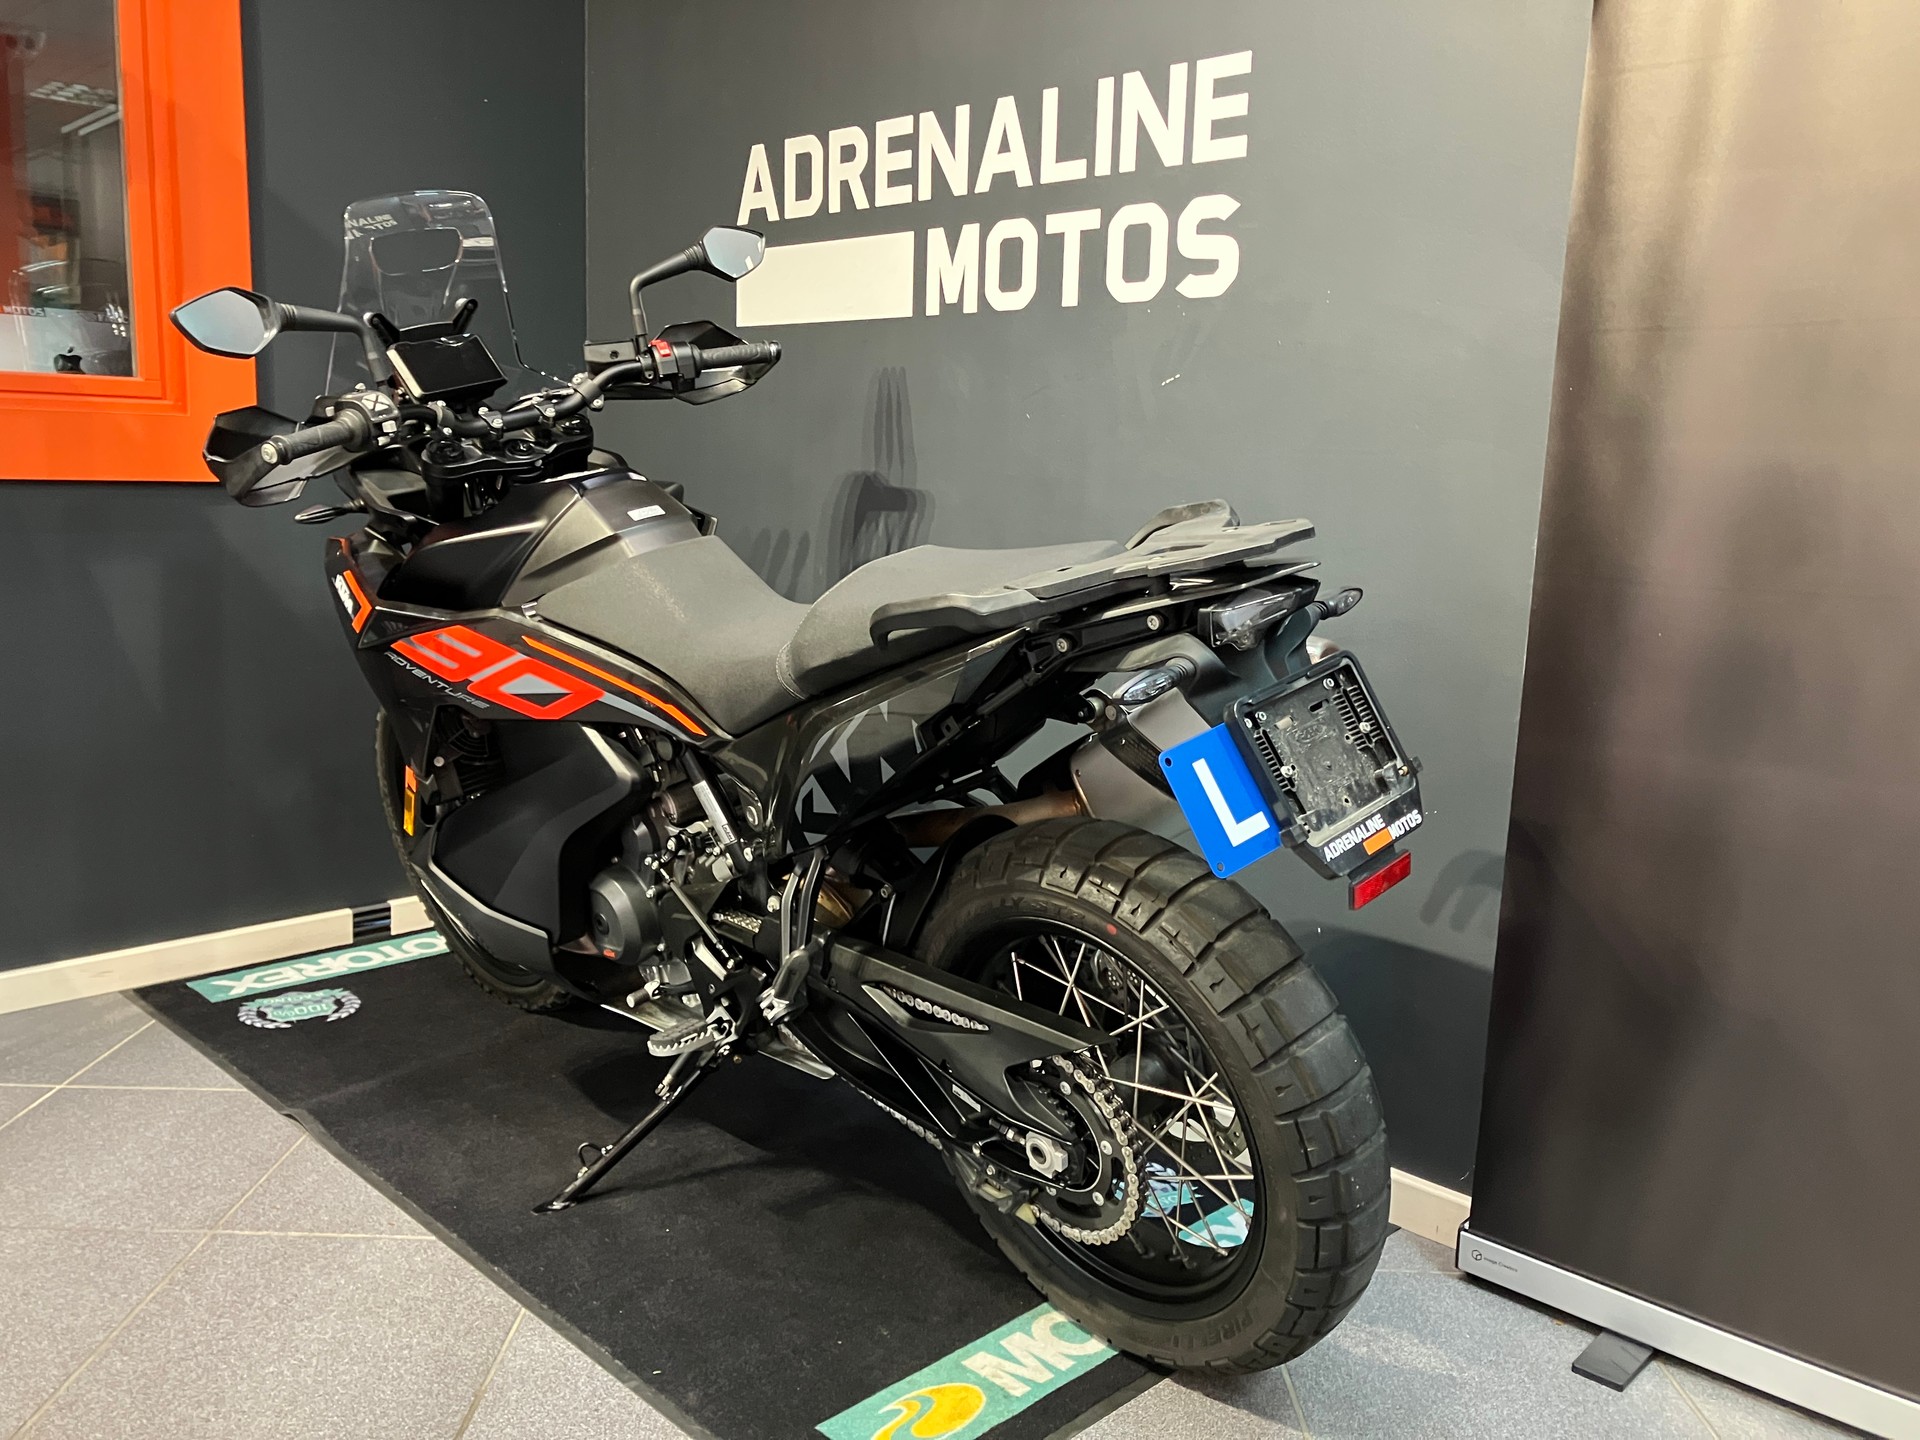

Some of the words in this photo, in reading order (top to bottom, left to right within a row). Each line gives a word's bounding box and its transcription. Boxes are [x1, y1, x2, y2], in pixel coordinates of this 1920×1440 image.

[736, 49, 1253, 226] ADRENALINE
[925, 193, 1241, 317] MOTOS
[384, 651, 490, 710] ADVENTURE
[1191, 757, 1271, 848] L
[1387, 809, 1423, 840] MOTOS
[1323, 813, 1386, 862] ADRENALINE
[212, 935, 446, 994] OTOREX
[273, 1003, 327, 1017] 100%
